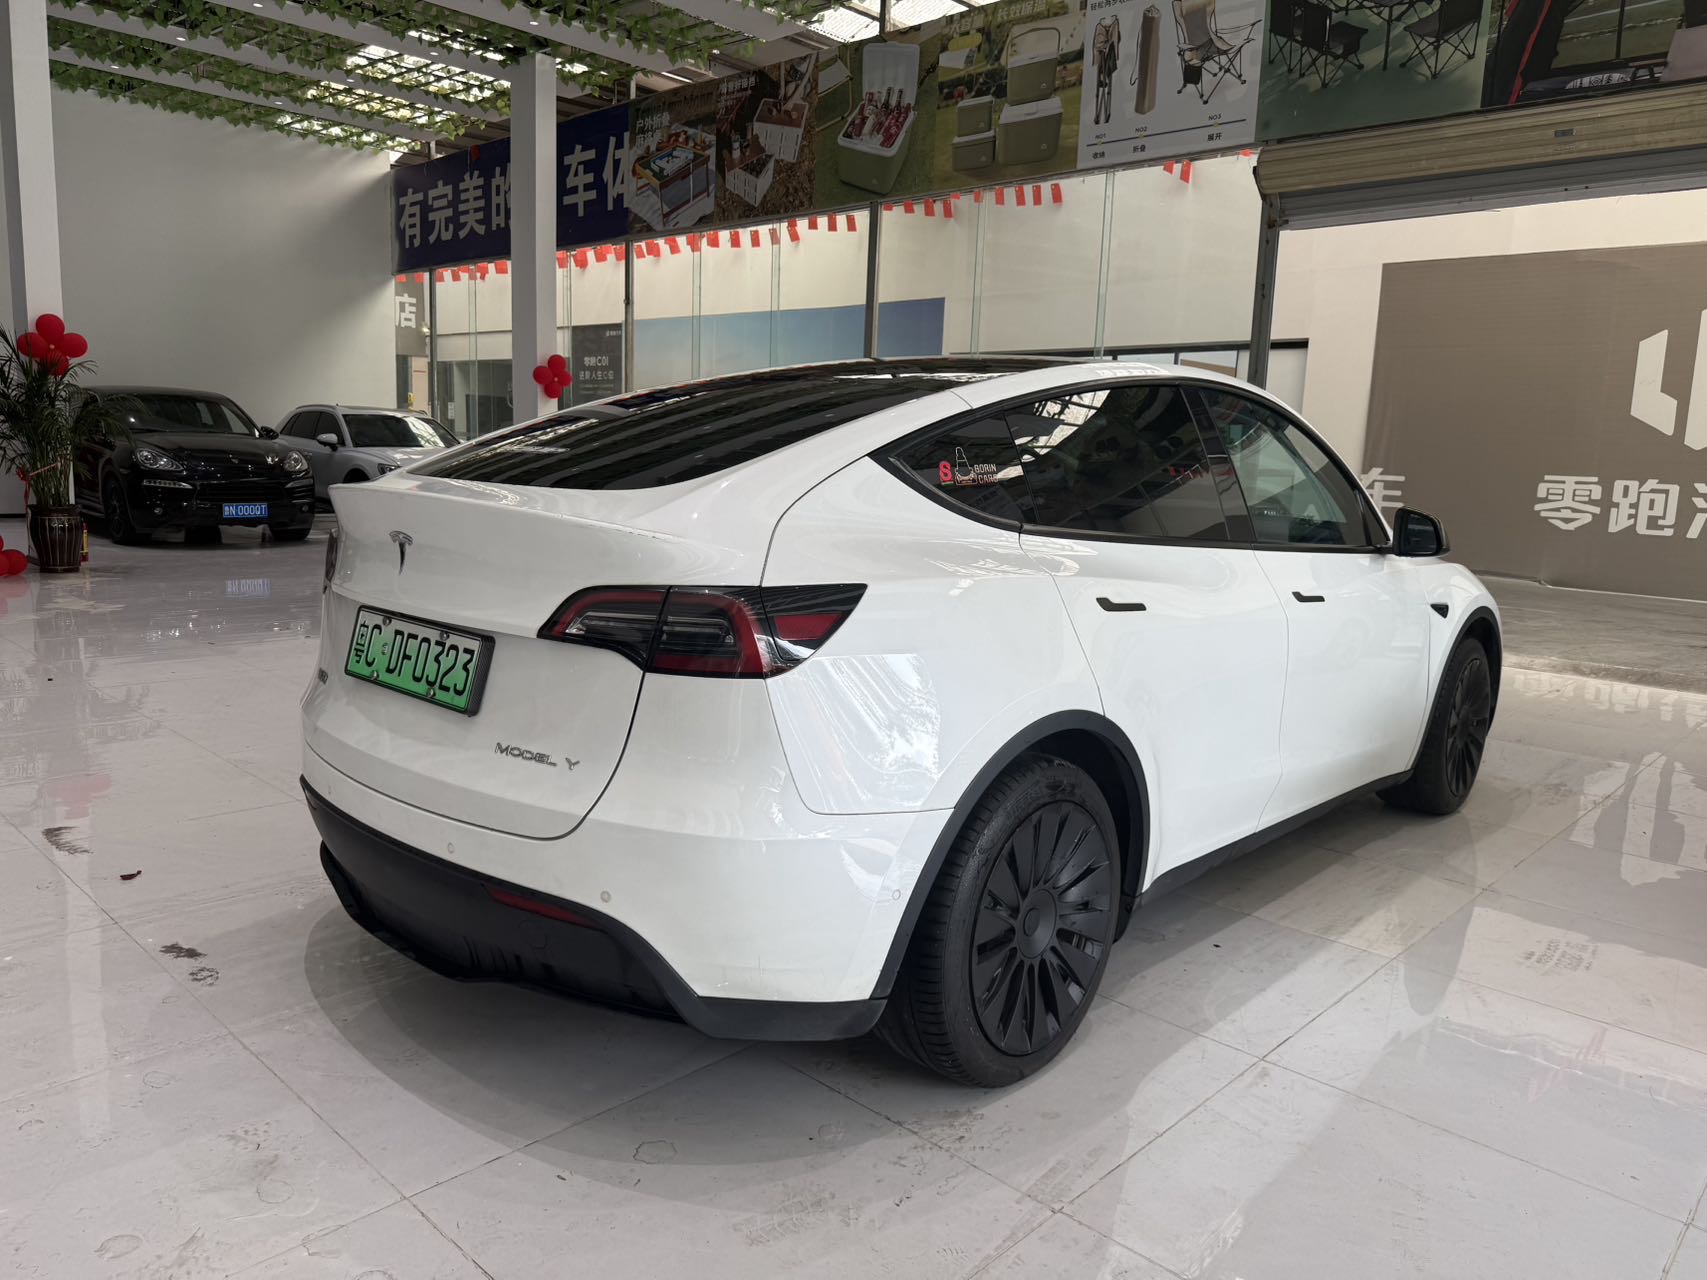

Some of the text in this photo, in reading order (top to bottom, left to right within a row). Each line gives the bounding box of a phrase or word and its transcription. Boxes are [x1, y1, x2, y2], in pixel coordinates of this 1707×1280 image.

[1208, 113, 1222, 121] NO3
[1135, 126, 1148, 134] NO2
[395, 293, 417, 328] 店
[494, 742, 581, 771] MODEL Y
